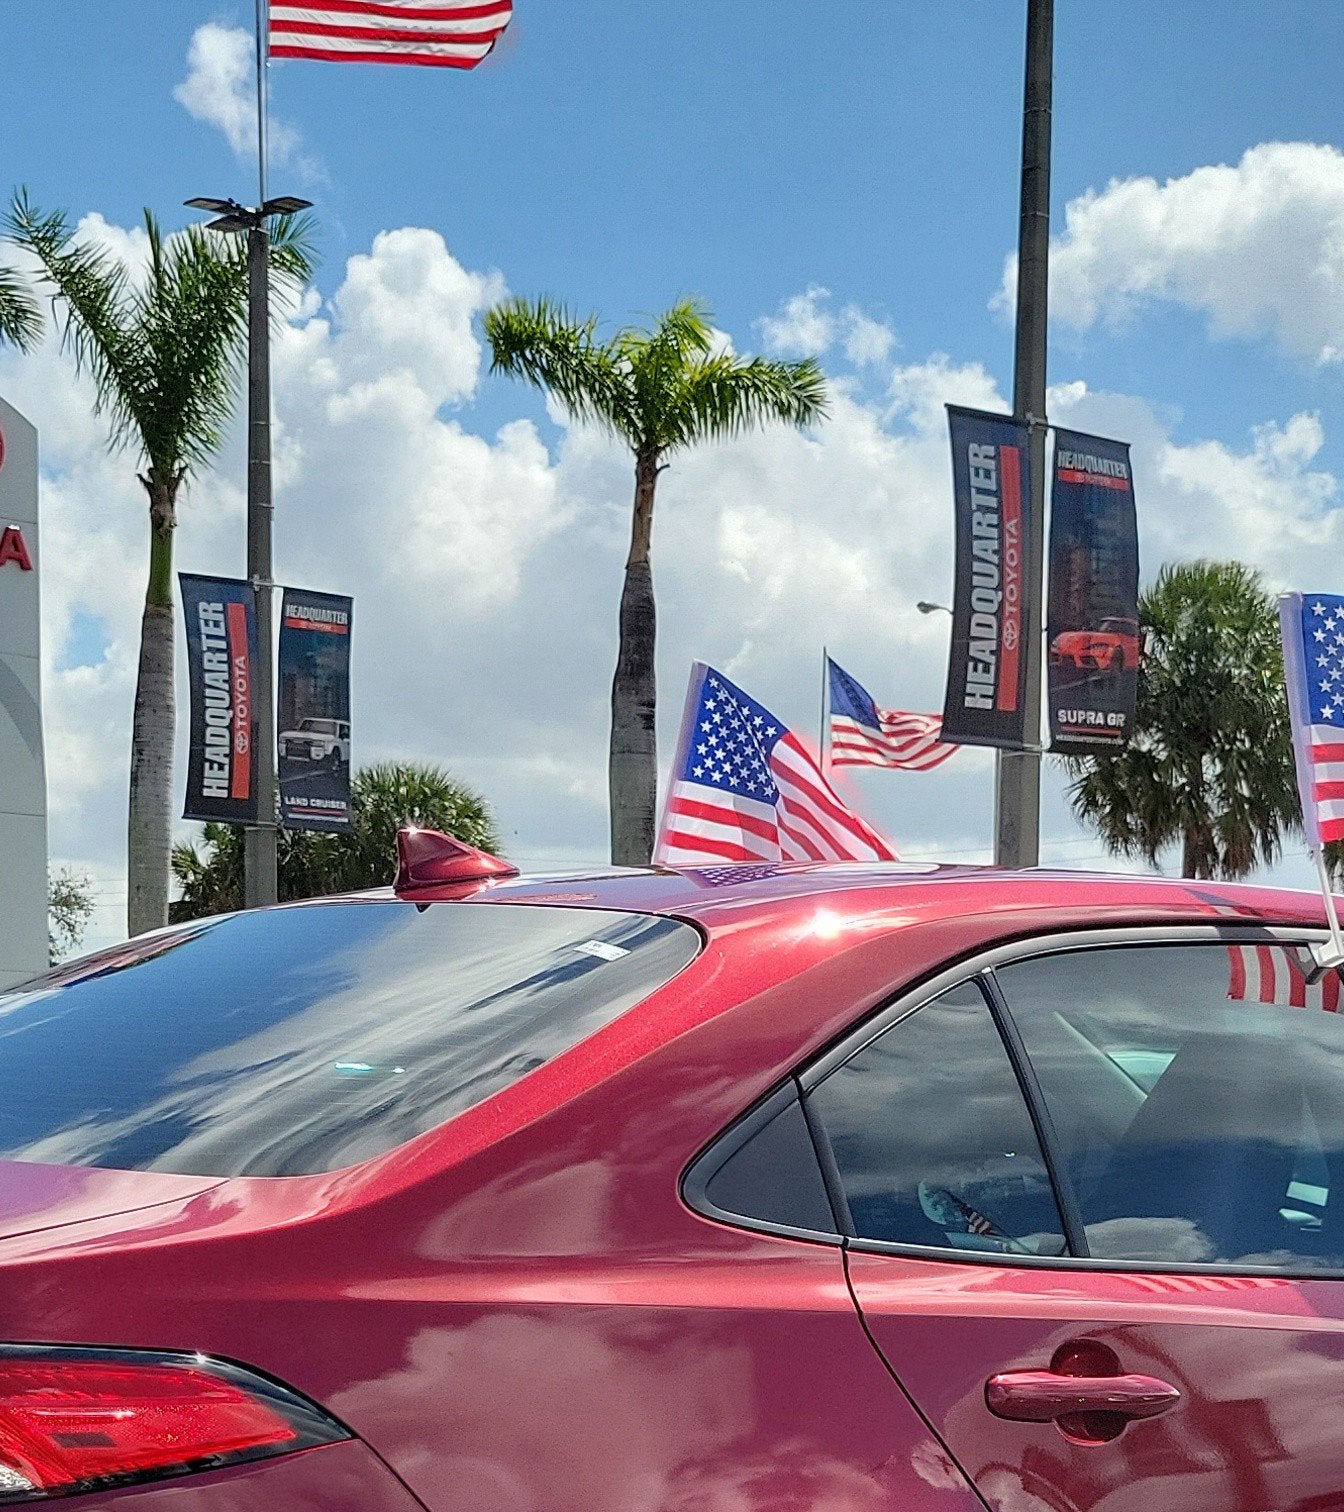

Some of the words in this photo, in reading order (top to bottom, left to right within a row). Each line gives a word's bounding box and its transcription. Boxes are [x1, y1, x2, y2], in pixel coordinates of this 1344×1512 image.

[1058, 449, 1128, 479] HEADQUARTER
[964, 442, 1002, 711] HEADQUARTER
[1005, 519, 1019, 617] TOYOTA
[285, 604, 348, 625] HEADQUARTER
[199, 601, 233, 798] HEADQUARTER
[233, 656, 248, 727] TOYOTA
[1058, 709, 1104, 725] SUPRA
[1106, 712, 1125, 727] GR
